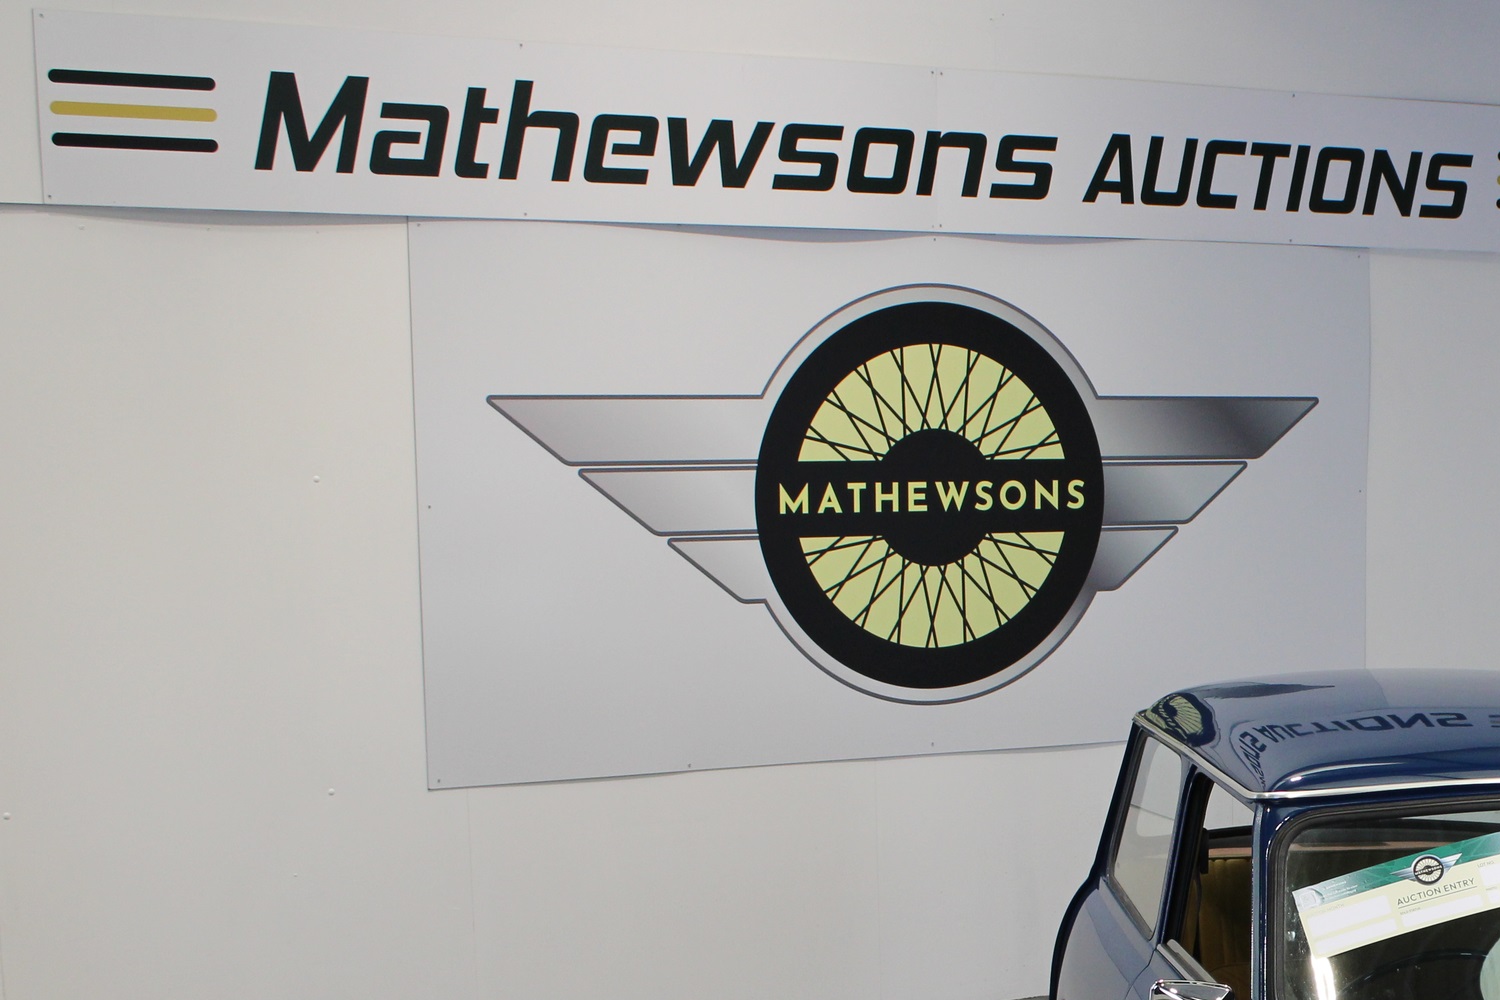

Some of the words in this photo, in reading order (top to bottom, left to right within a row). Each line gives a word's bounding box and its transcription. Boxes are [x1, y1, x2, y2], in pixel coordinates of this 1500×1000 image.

[254, 71, 1058, 200] Mathewsons
[1082, 133, 1474, 219] AUCTIONS
[778, 479, 1085, 515] MATHEWSONS
[1397, 887, 1441, 906] AUCTION
[1443, 877, 1475, 893] ENTRY
